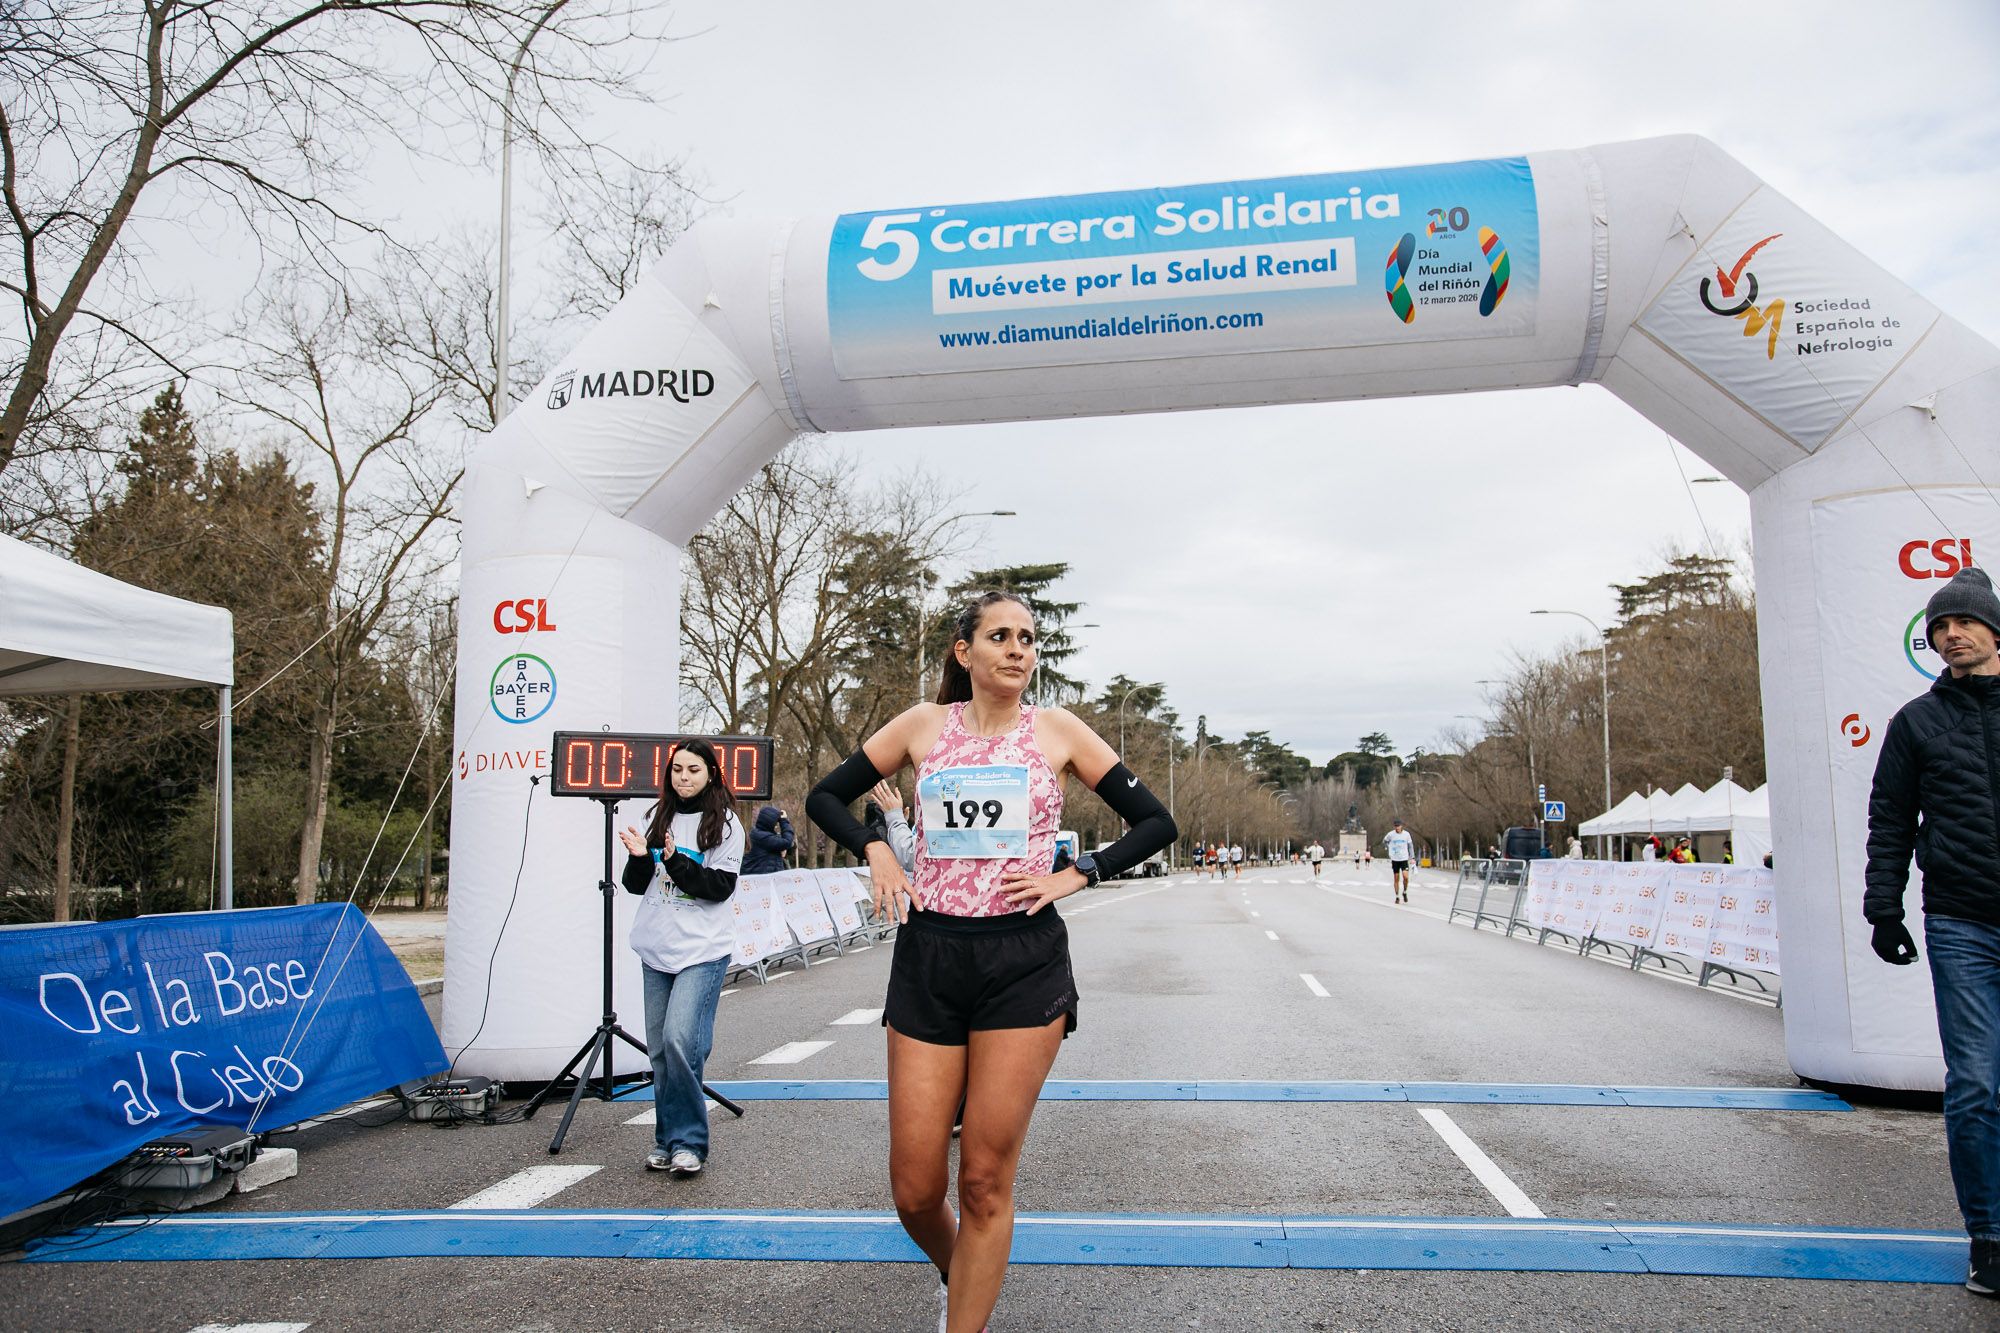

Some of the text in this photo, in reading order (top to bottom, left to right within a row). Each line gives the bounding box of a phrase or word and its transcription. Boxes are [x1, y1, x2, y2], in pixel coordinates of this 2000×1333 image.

[930, 214, 1136, 253] Carrera
[1153, 186, 1401, 237] Solidaria
[1418, 249, 1440, 260] Día
[949, 248, 1338, 300] Muévete por la Salud Renal
[1418, 261, 1473, 276] Mundial
[1418, 278, 1481, 292] del Riñón
[1420, 294, 1479, 305] 12 marzo 2026
[1794, 298, 1871, 314] Sociedad
[939, 309, 1264, 348] www.diamundialdelriñon.com
[1796, 317, 1901, 336] Española de
[1797, 335, 1894, 356] Nefrología
[580, 369, 715, 404] MADRID
[493, 598, 557, 635] CSL
[494, 681, 550, 696] BAYER
[516, 659, 527, 719] BAYER
[476, 748, 547, 773] DIAVE
[942, 799, 1003, 829] 199
[1628, 924, 1651, 939] GSK
[39, 950, 315, 1035] De la Base
[112, 1044, 305, 1126] al Cielo
